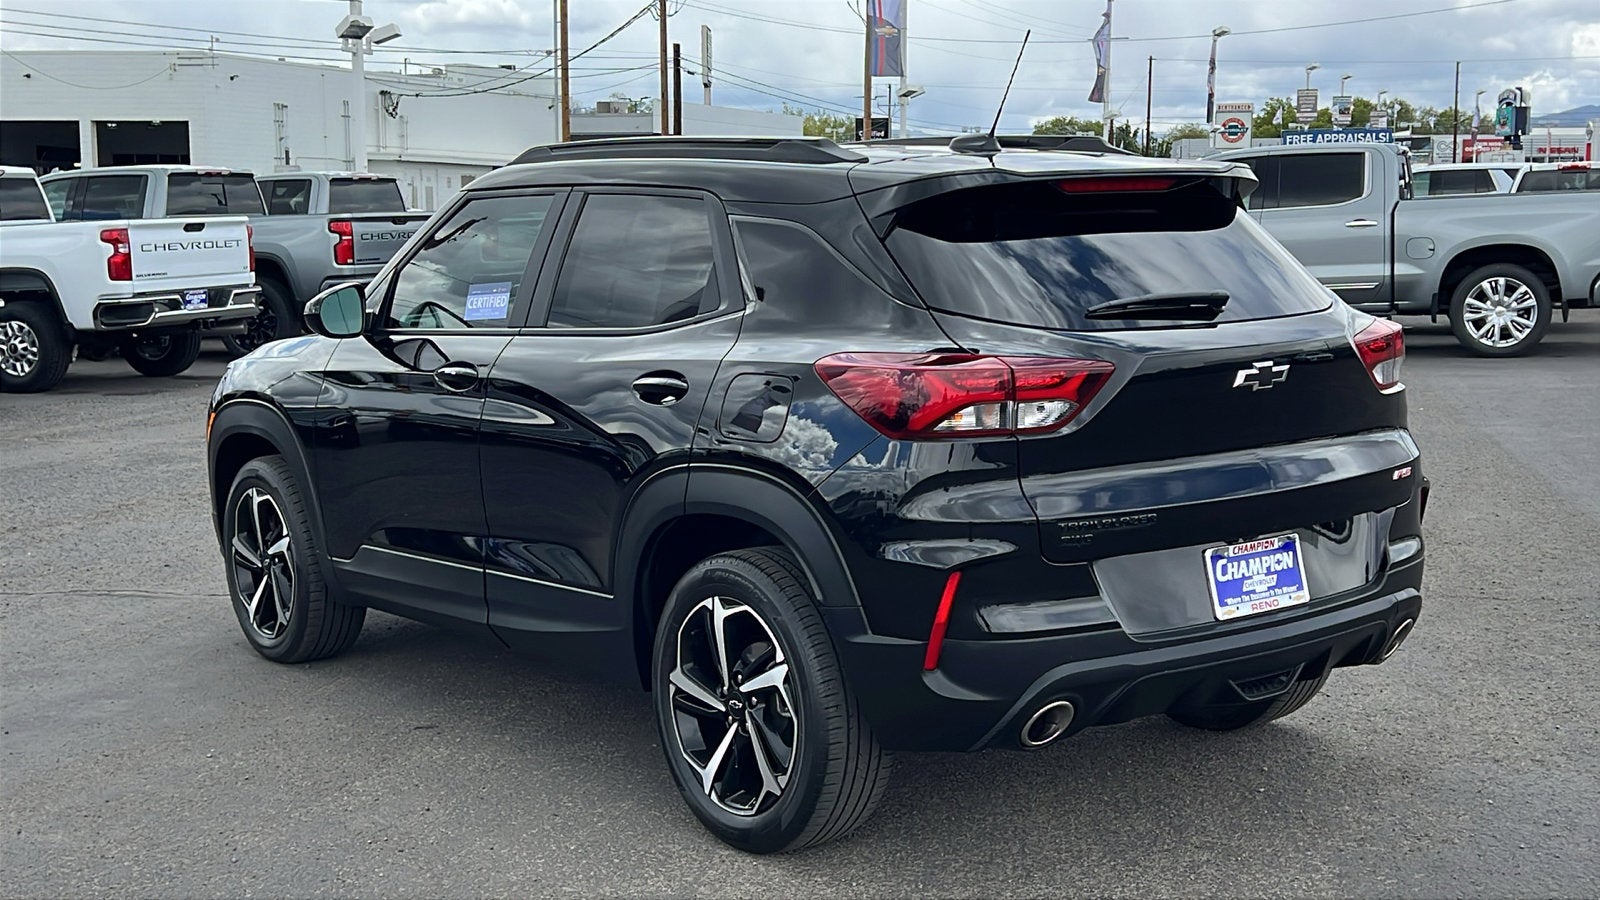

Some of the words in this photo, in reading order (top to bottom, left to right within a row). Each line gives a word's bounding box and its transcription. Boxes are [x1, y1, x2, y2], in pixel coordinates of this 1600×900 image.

[1286, 134, 1313, 146] FREE
[1316, 132, 1389, 143] APPRAISALS!
[141, 239, 242, 253] CHEVROLET
[467, 295, 508, 309] CERTIFIED
[1058, 512, 1158, 531] TRAILBLAZER
[1232, 539, 1276, 555] CHAMPION
[1244, 576, 1276, 590] CHEVROLET
[1251, 598, 1280, 612] RENO
